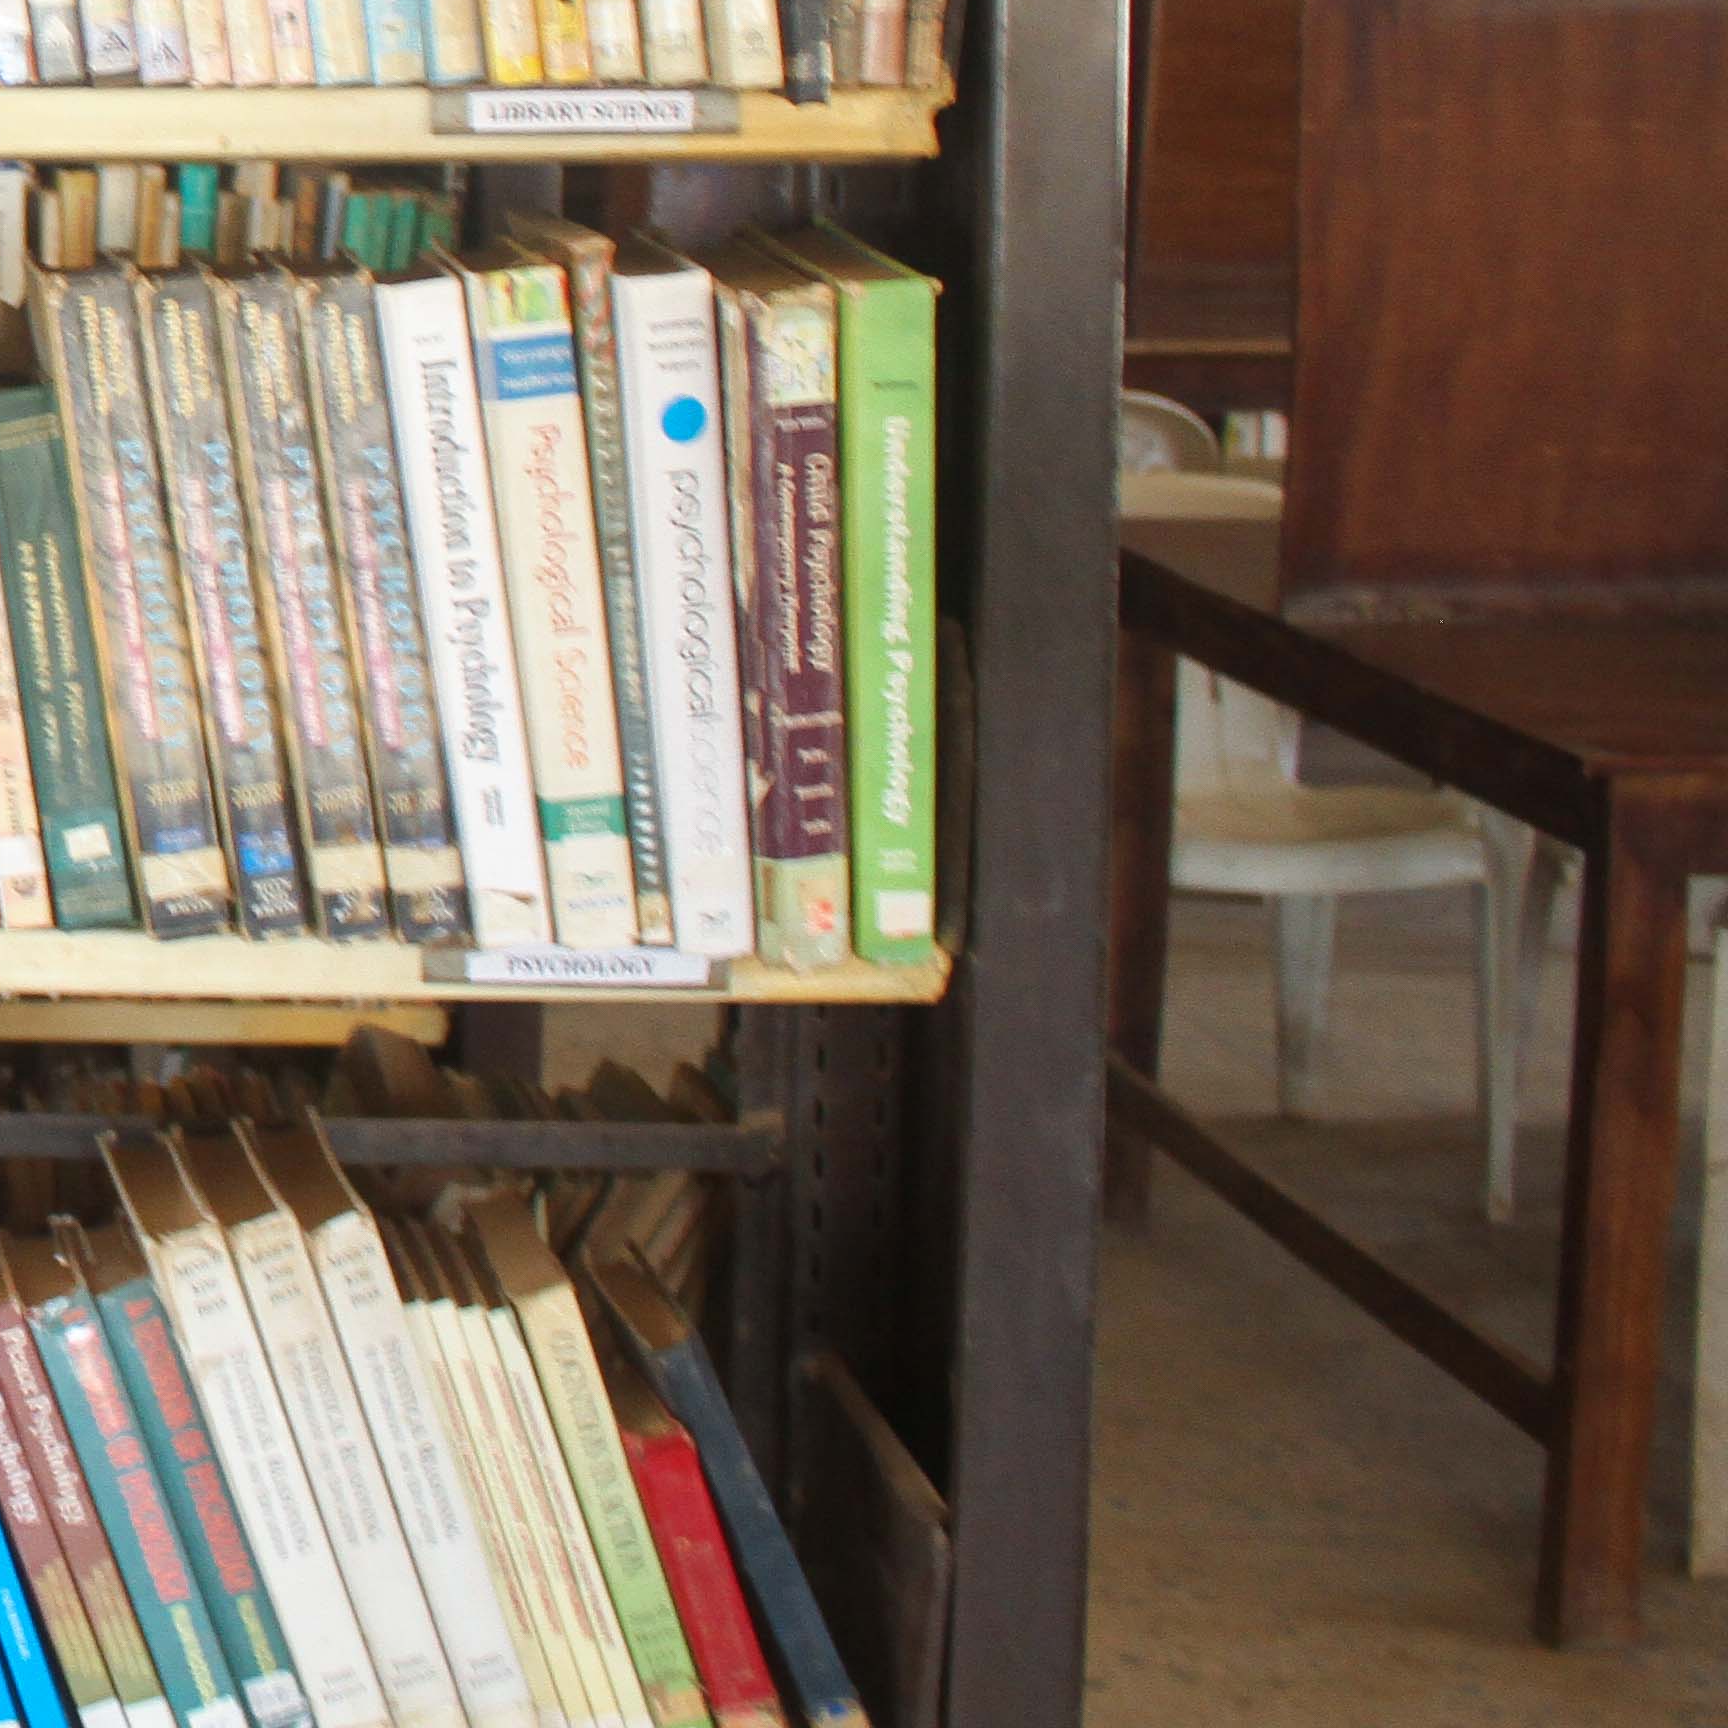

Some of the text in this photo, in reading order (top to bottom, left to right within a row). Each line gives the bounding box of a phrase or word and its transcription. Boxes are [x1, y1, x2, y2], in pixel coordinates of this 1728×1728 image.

[490, 101, 683, 122] LIBRARY SCIENCE
[418, 355, 513, 767] Introduction Psychology
[520, 421, 599, 770] Psychological Science
[663, 467, 725, 722] psychological
[507, 954, 654, 977] PSYCHOLOGY
